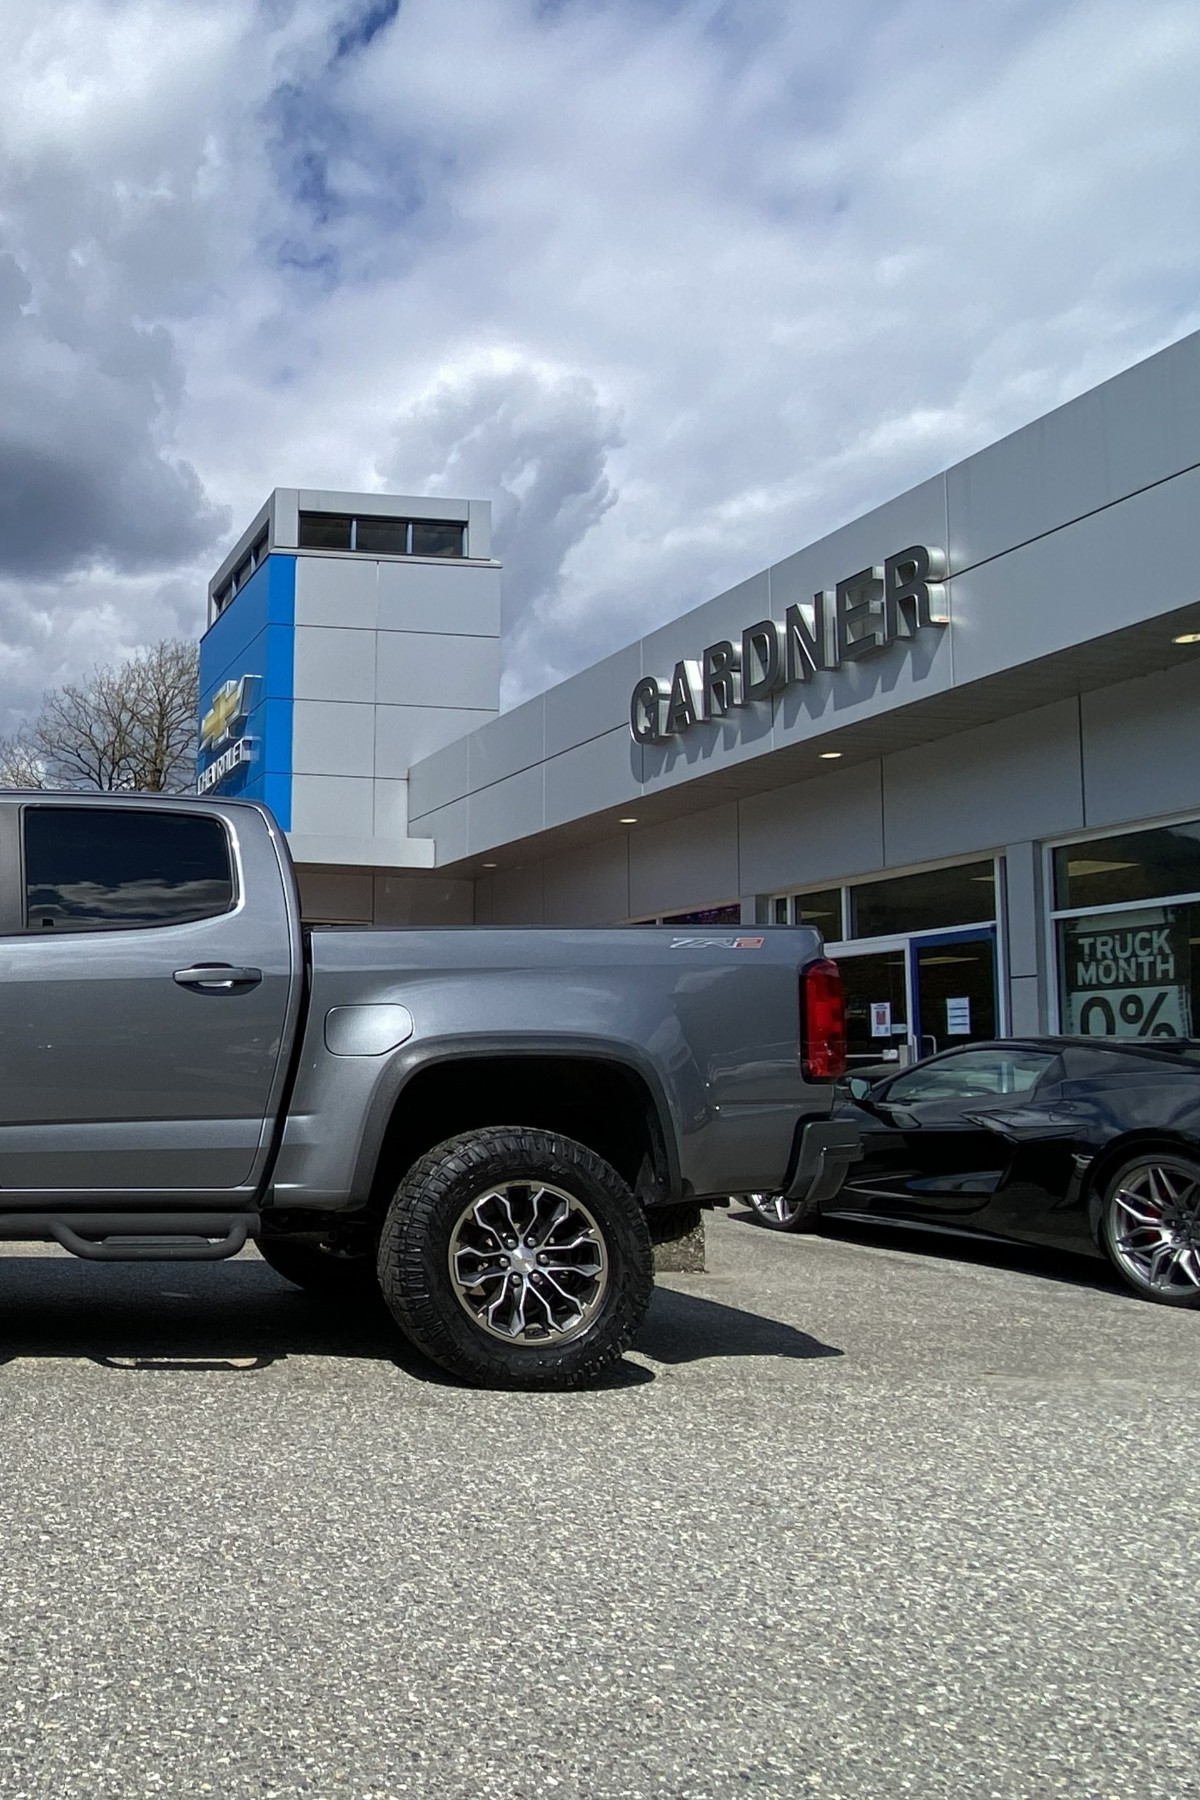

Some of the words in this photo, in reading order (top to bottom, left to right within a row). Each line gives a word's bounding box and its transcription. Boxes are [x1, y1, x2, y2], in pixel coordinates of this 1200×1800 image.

[630, 545, 942, 745] GARDNER
[1078, 929, 1172, 961] TRUCK
[1077, 955, 1175, 986] MONTH
